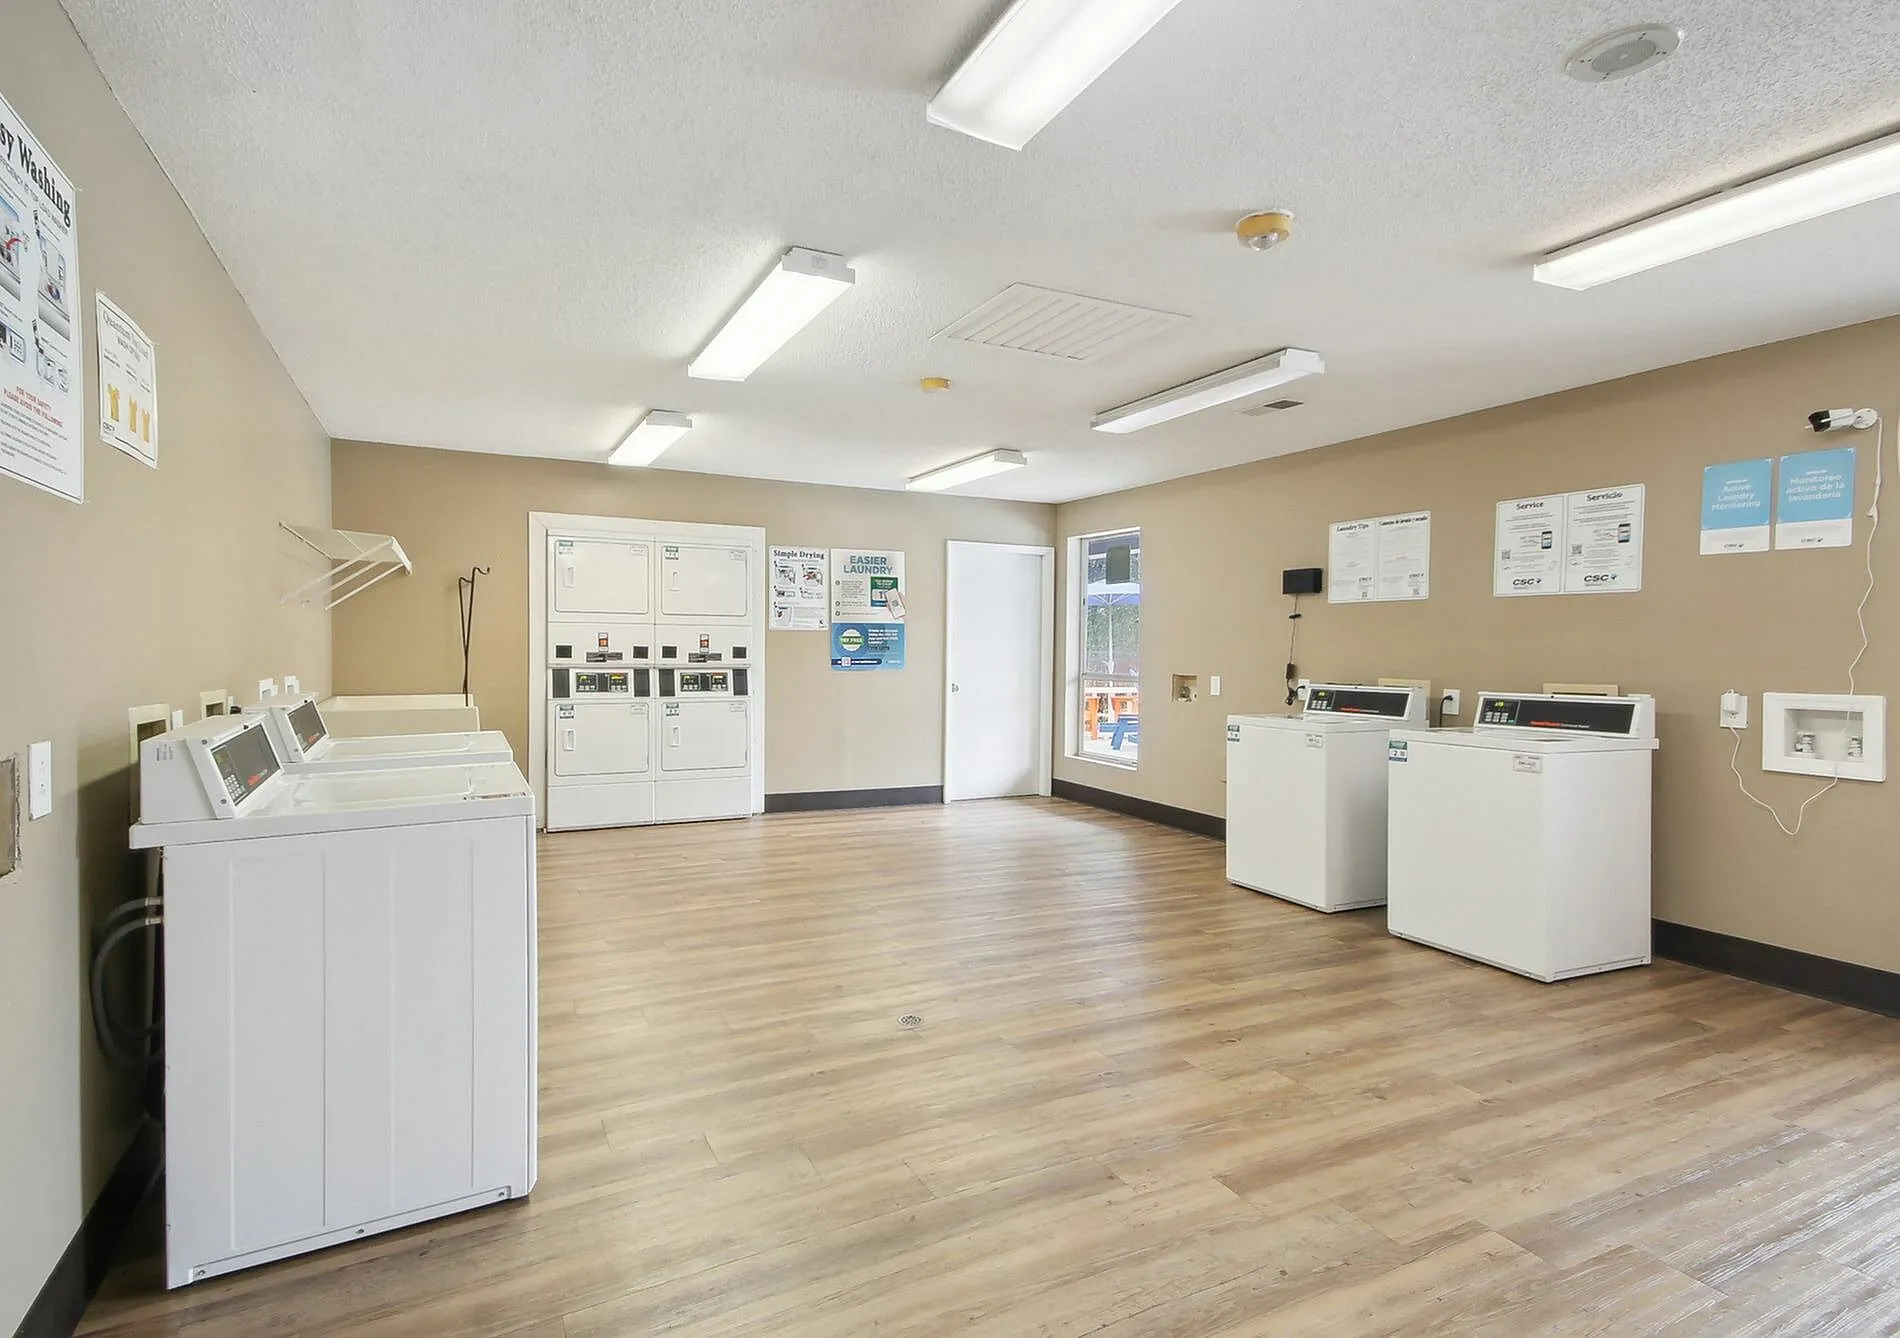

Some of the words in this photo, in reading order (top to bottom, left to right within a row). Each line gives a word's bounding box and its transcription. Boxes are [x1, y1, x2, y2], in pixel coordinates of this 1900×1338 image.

[17, 135, 70, 228] Washing
[1586, 491, 1623, 501] Servicio
[1515, 501, 1544, 510] Service
[773, 549, 798, 559] Simple
[799, 551, 825, 560] Drying
[850, 555, 887, 565] EASIER
[843, 565, 893, 575] LAUNDRY
[1513, 578, 1535, 586] CSC
[1584, 574, 1609, 582] CSC
